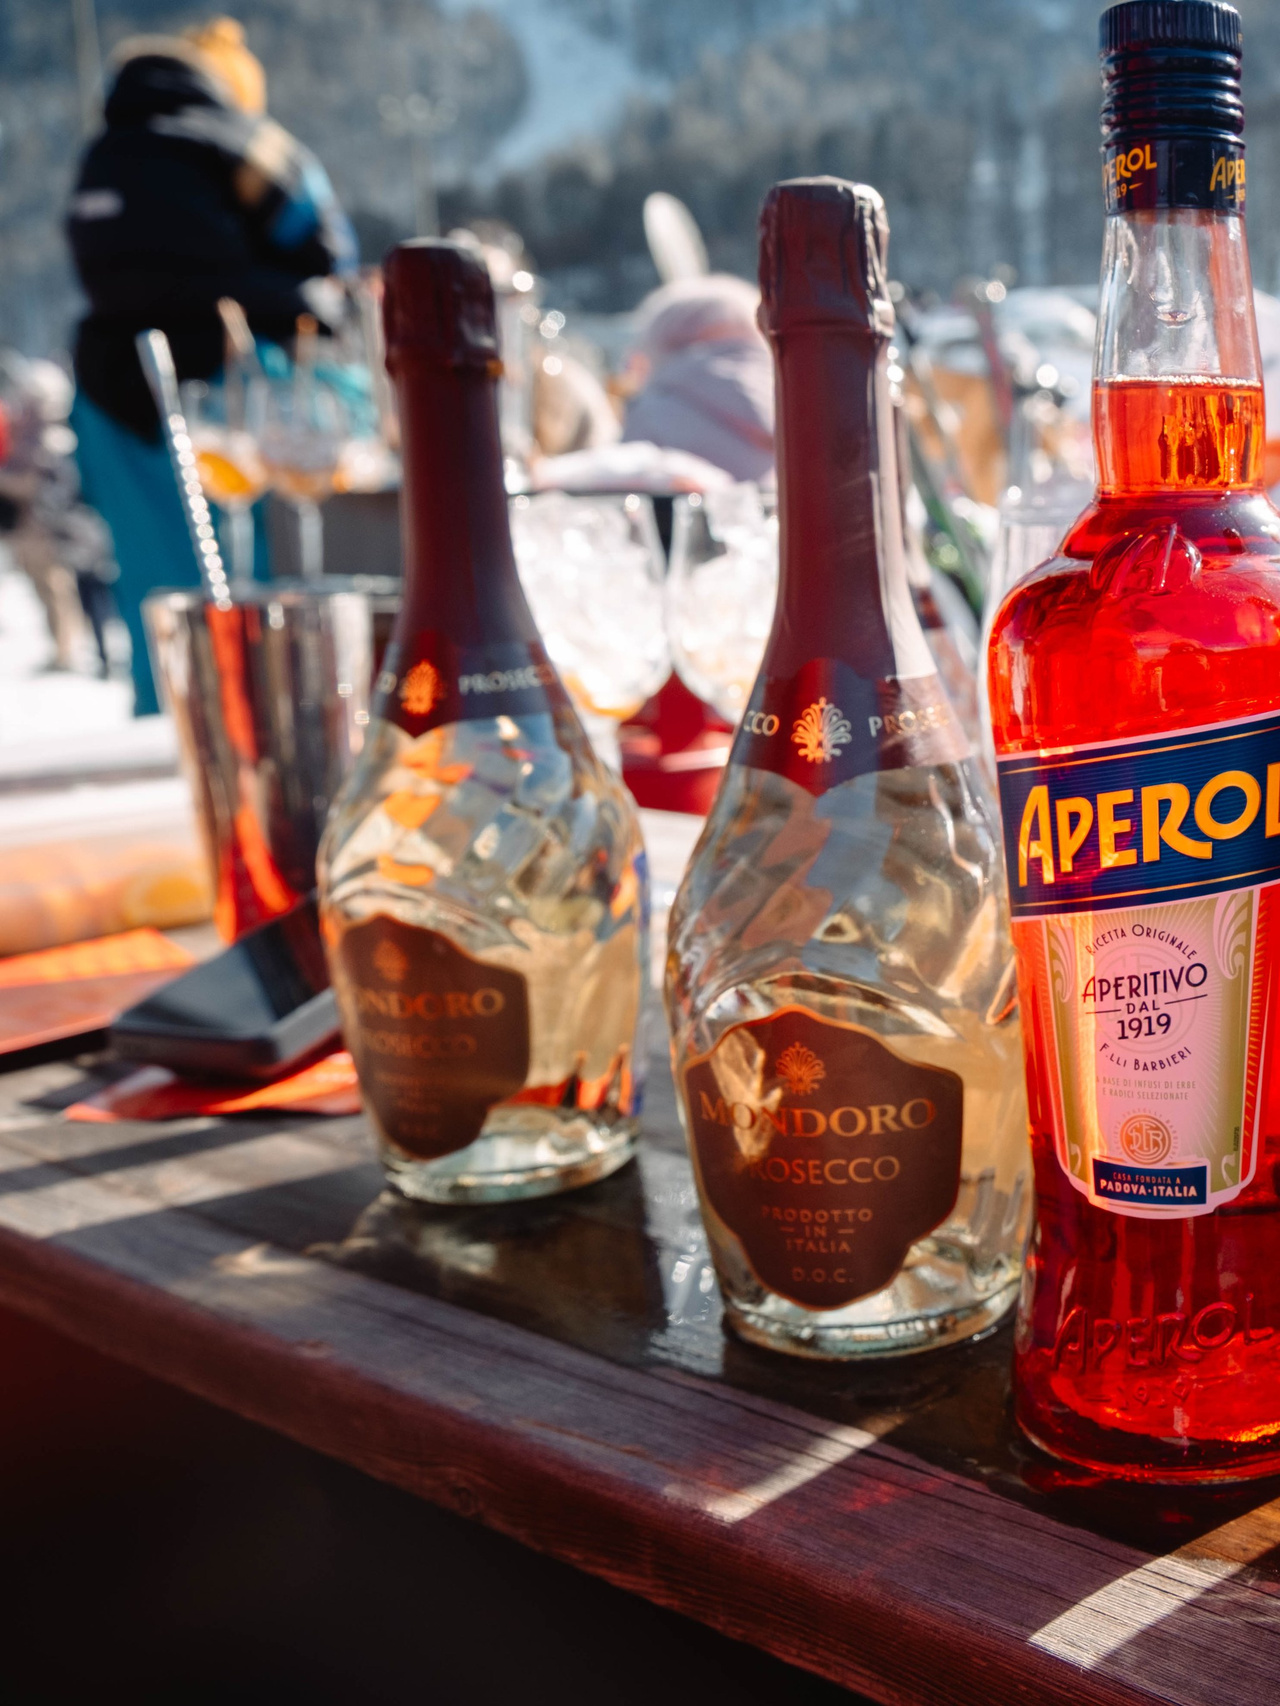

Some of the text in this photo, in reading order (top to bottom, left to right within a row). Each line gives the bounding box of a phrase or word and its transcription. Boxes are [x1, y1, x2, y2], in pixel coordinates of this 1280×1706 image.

[1085, 923, 1197, 960] RICETTA ORIGINALE
[1081, 962, 1208, 1003] APERITIVO
[1126, 999, 1161, 1015] DAL
[1117, 1013, 1171, 1040] 1919
[1134, 1046, 1192, 1072] BARBIERI
[1102, 1076, 1120, 1086] BASE
[1123, 1078, 1132, 1087] DI
[1134, 1079, 1161, 1089] INFUSI
[1164, 1080, 1173, 1089] DI
[1176, 1080, 1197, 1090] ERBE
[1109, 1088, 1134, 1099] RADICI
[1137, 1091, 1189, 1101] SELEZIONATE
[699, 1090, 936, 1138] MONDORO
[735, 1155, 901, 1185] ROSECCO
[1112, 1171, 1181, 1184] CASA FONDATA A
[761, 1206, 874, 1223] PRODOTTO
[804, 1225, 827, 1239] IN
[785, 1238, 852, 1254] ITALIA
[1049, 1293, 1274, 1376] APEROL
